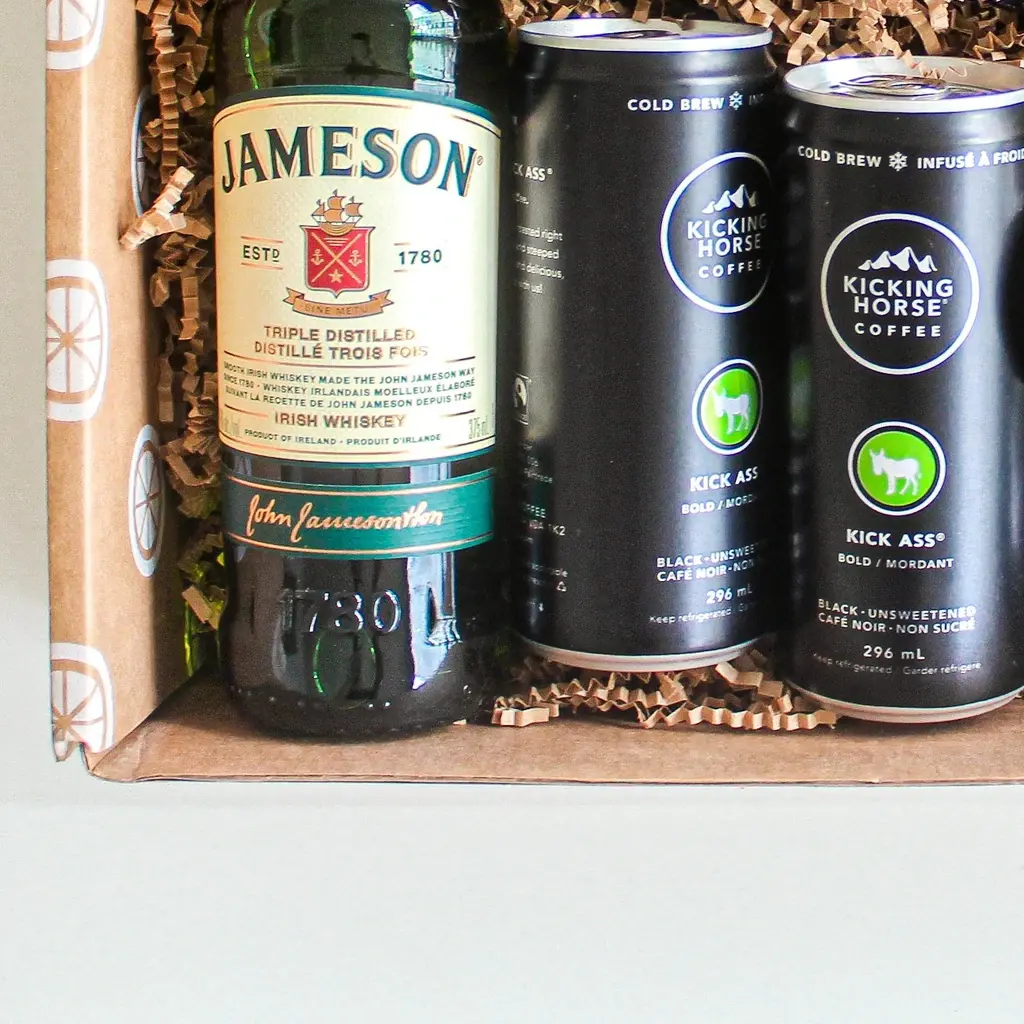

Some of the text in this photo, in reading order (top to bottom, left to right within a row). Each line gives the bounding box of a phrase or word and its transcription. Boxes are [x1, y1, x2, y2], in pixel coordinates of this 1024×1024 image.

[627, 97, 725, 112] COLD BREW
[797, 145, 831, 162] COLD
[836, 153, 882, 168] BREW
[917, 151, 975, 169] INFUSÉ
[687, 213, 767, 239] KICKING
[697, 233, 762, 258] HORSE
[398, 249, 443, 266] 1780
[698, 258, 762, 279] COFFEE
[843, 275, 954, 298] KICKING
[304, 304, 369, 315] SINE METU
[264, 326, 416, 342] TRIPLE DISTILLED
[854, 322, 942, 337] COFFEE
[254, 341, 430, 360] DISTILLÉ TROIS FOIS
[246, 368, 268, 379] IRISH
[270, 372, 316, 383] WHISKEY
[319, 376, 350, 385] MADE
[353, 376, 376, 385] THE
[379, 375, 408, 384] JOHN
[411, 370, 456, 383] JAMESON
[458, 367, 475, 377] WAY
[263, 382, 308, 395] WHISKEY
[310, 387, 371, 397] IRLANDAIS
[374, 385, 433, 396] MOELLEUX
[250, 393, 260, 401] LA
[263, 394, 307, 407] RECETTE
[309, 399, 324, 408] DE
[328, 400, 356, 409] JOHN
[360, 399, 413, 409] JAMESON
[416, 395, 452, 406] DEPUIS
[274, 412, 406, 429] IRISH WHISKEY
[244, 429, 278, 441] PRODUCT
[295, 436, 337, 445] IRELAND
[346, 438, 390, 446] PRODUIT
[393, 434, 441, 445] D'IRLANDE
[690, 466, 759, 492] KICK ASS
[245, 494, 291, 537] John
[681, 501, 715, 514] BOLD
[846, 528, 892, 547] KICK
[656, 555, 703, 568] BLACK
[838, 553, 955, 569] BOLD MORDANT
[656, 567, 693, 582] CAFÉ
[695, 565, 727, 579] NOIR
[706, 588, 733, 604] 296
[818, 598, 977, 621] BLACK UNSWEETENED
[649, 615, 676, 624] Keep
[818, 612, 977, 634] CAFÉ NOIR NON SUCRÉ
[863, 644, 926, 660] 296 mL
[902, 666, 938, 675] Garder
